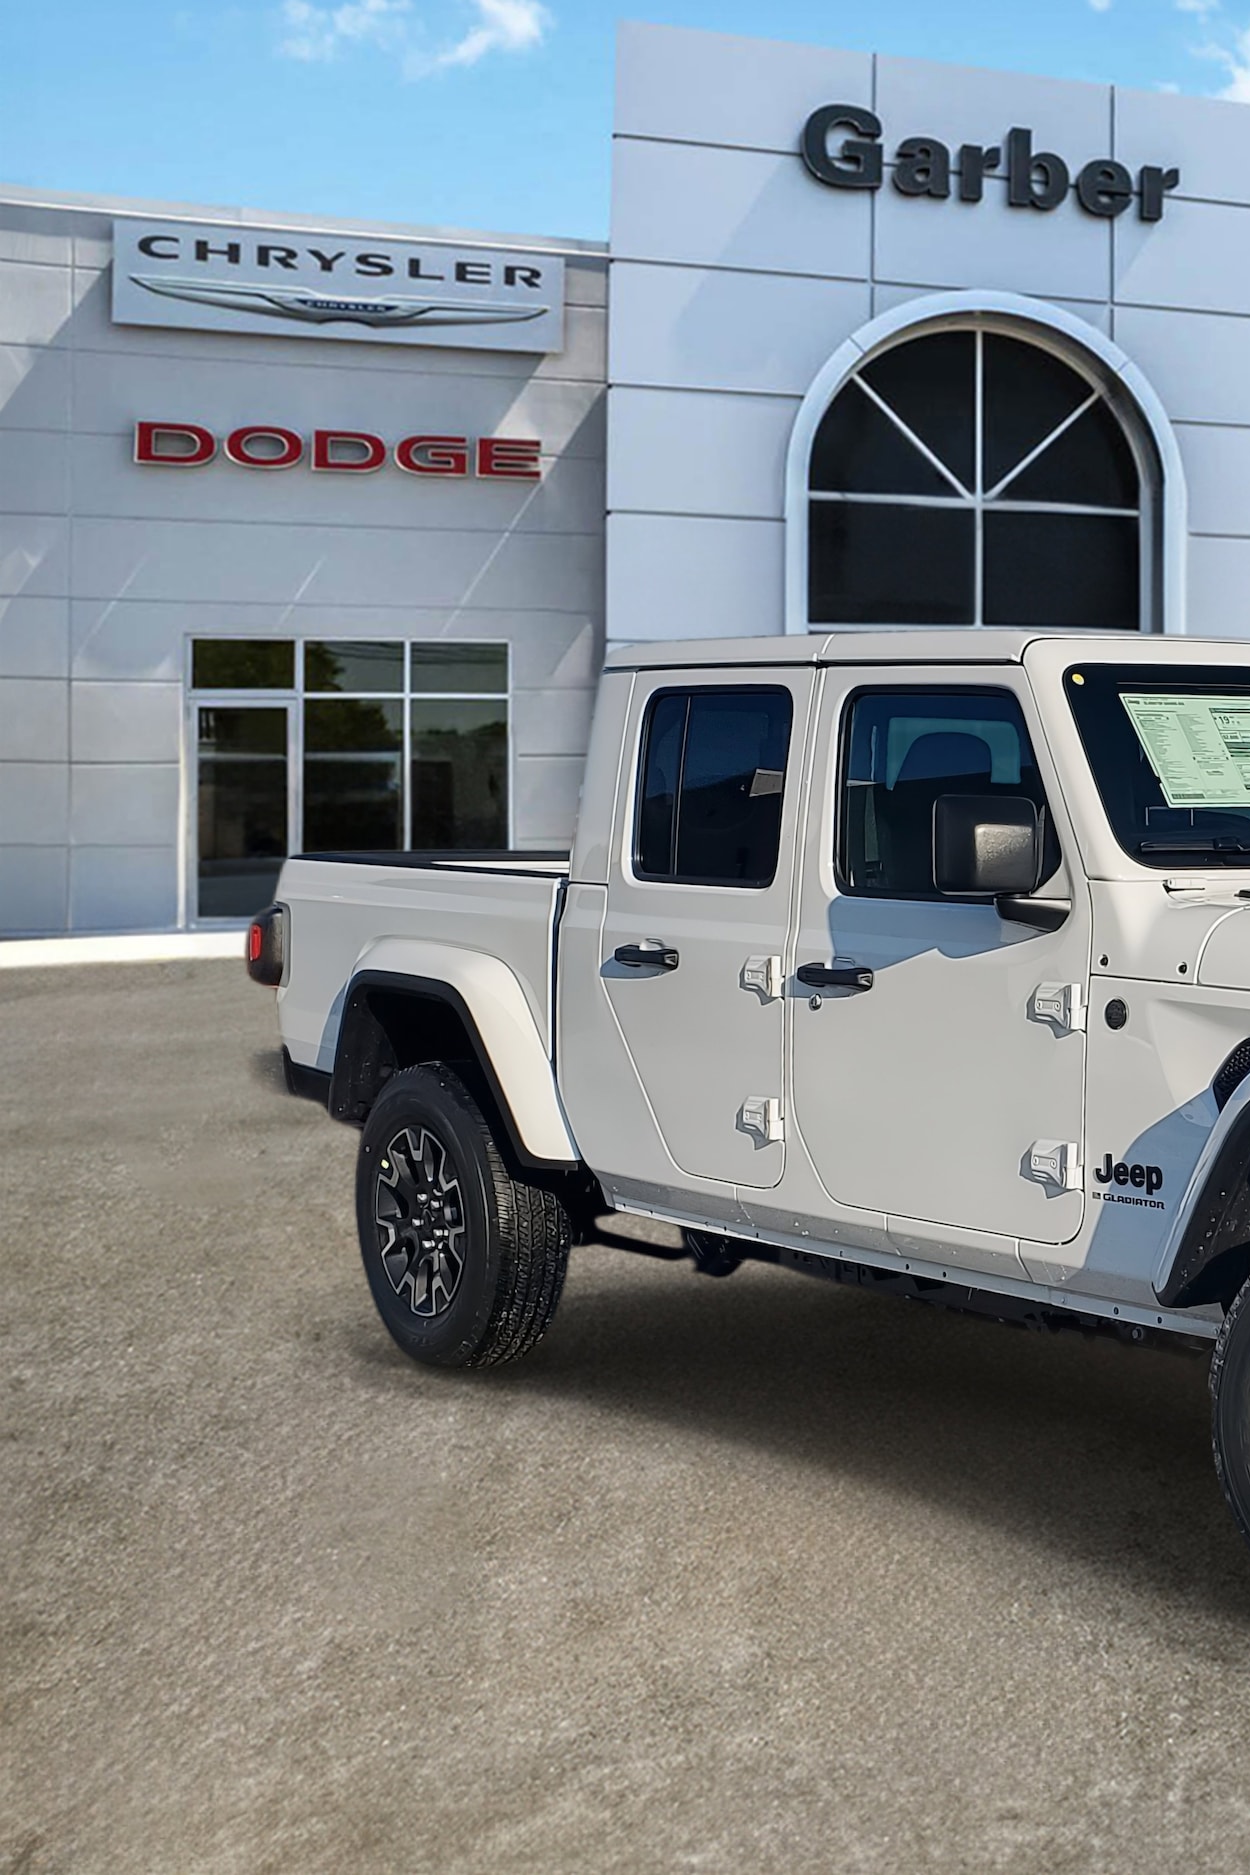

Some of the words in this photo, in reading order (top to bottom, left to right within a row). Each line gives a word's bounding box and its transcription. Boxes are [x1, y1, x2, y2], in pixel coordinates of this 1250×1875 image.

[802, 104, 1180, 222] Garber
[137, 235, 543, 288] CHRYSLER
[133, 420, 542, 479] DODGE
[1093, 1153, 1163, 1196] Jeep
[1102, 1192, 1165, 1210] GLADIATOR
